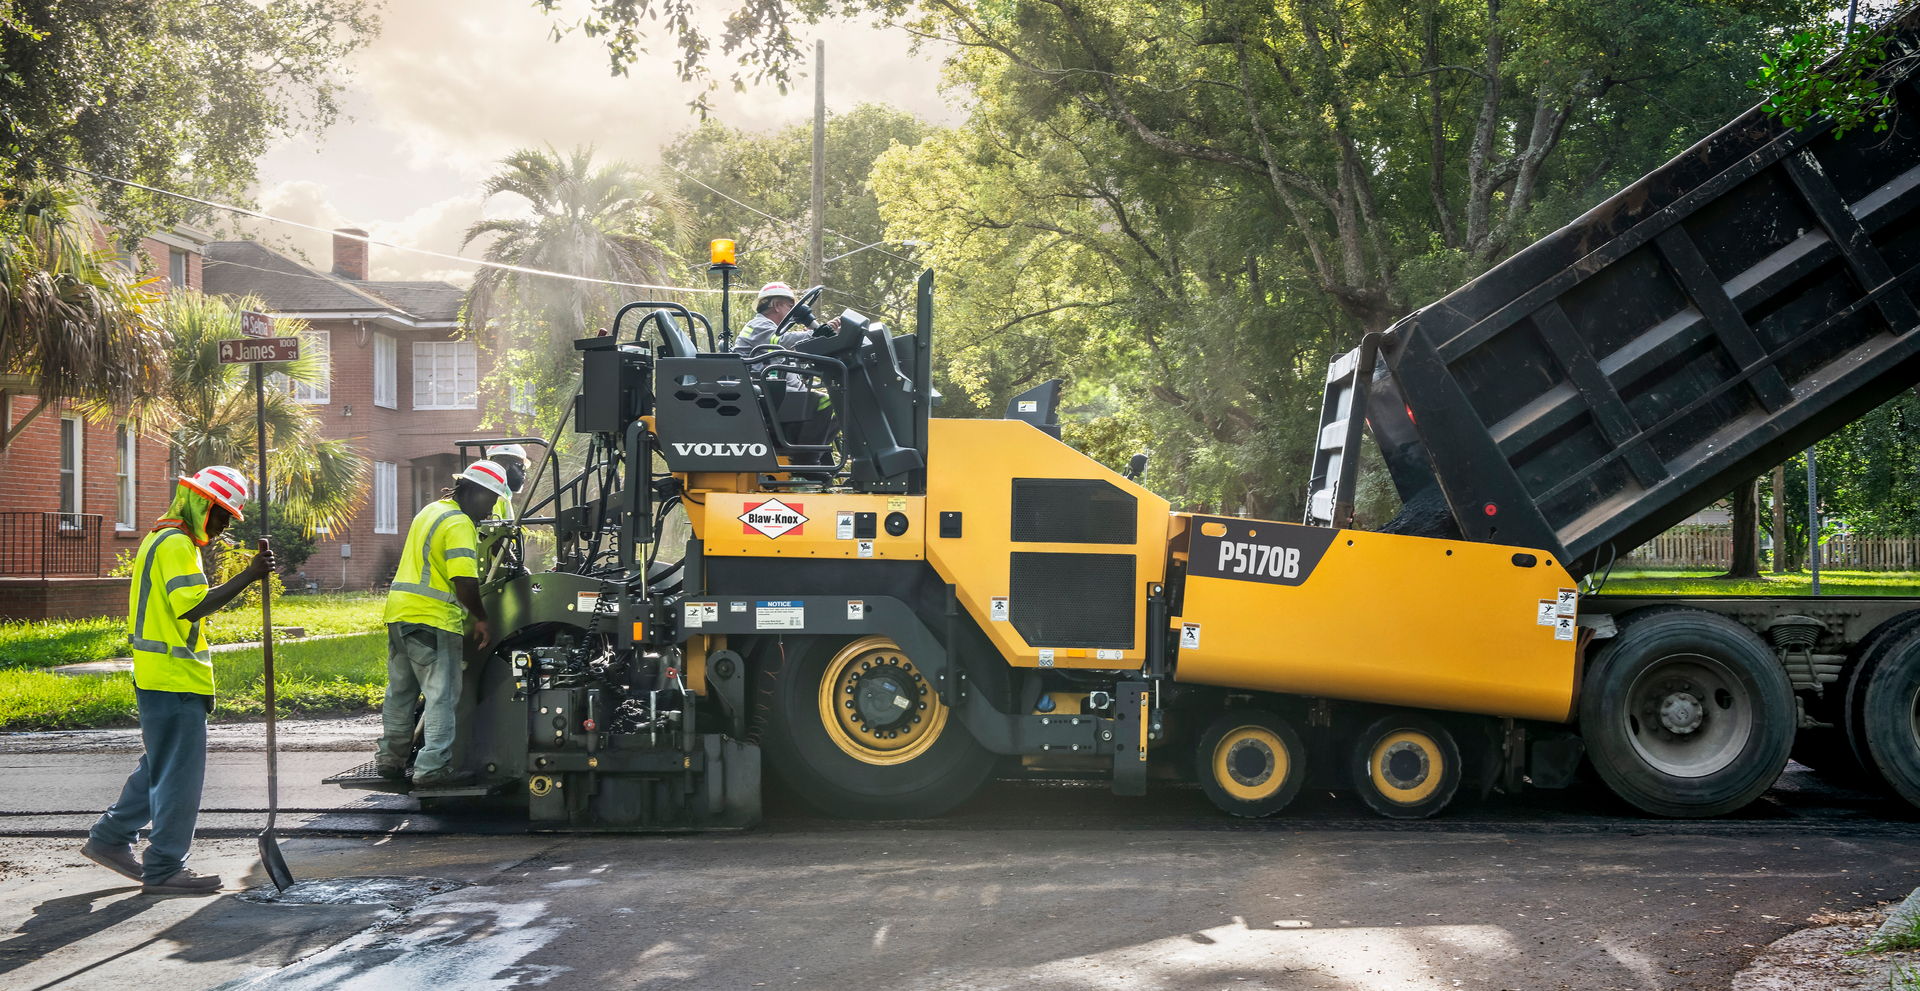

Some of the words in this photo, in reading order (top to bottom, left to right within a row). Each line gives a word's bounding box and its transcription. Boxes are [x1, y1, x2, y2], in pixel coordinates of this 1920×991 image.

[249, 315, 268, 336] Selma
[279, 339, 297, 348] 1000
[235, 342, 276, 361] James
[288, 350, 297, 359] St
[671, 442, 768, 457] VOLVO
[748, 513, 799, 524] Blaw-Knox
[1218, 540, 1300, 579] P5170B
